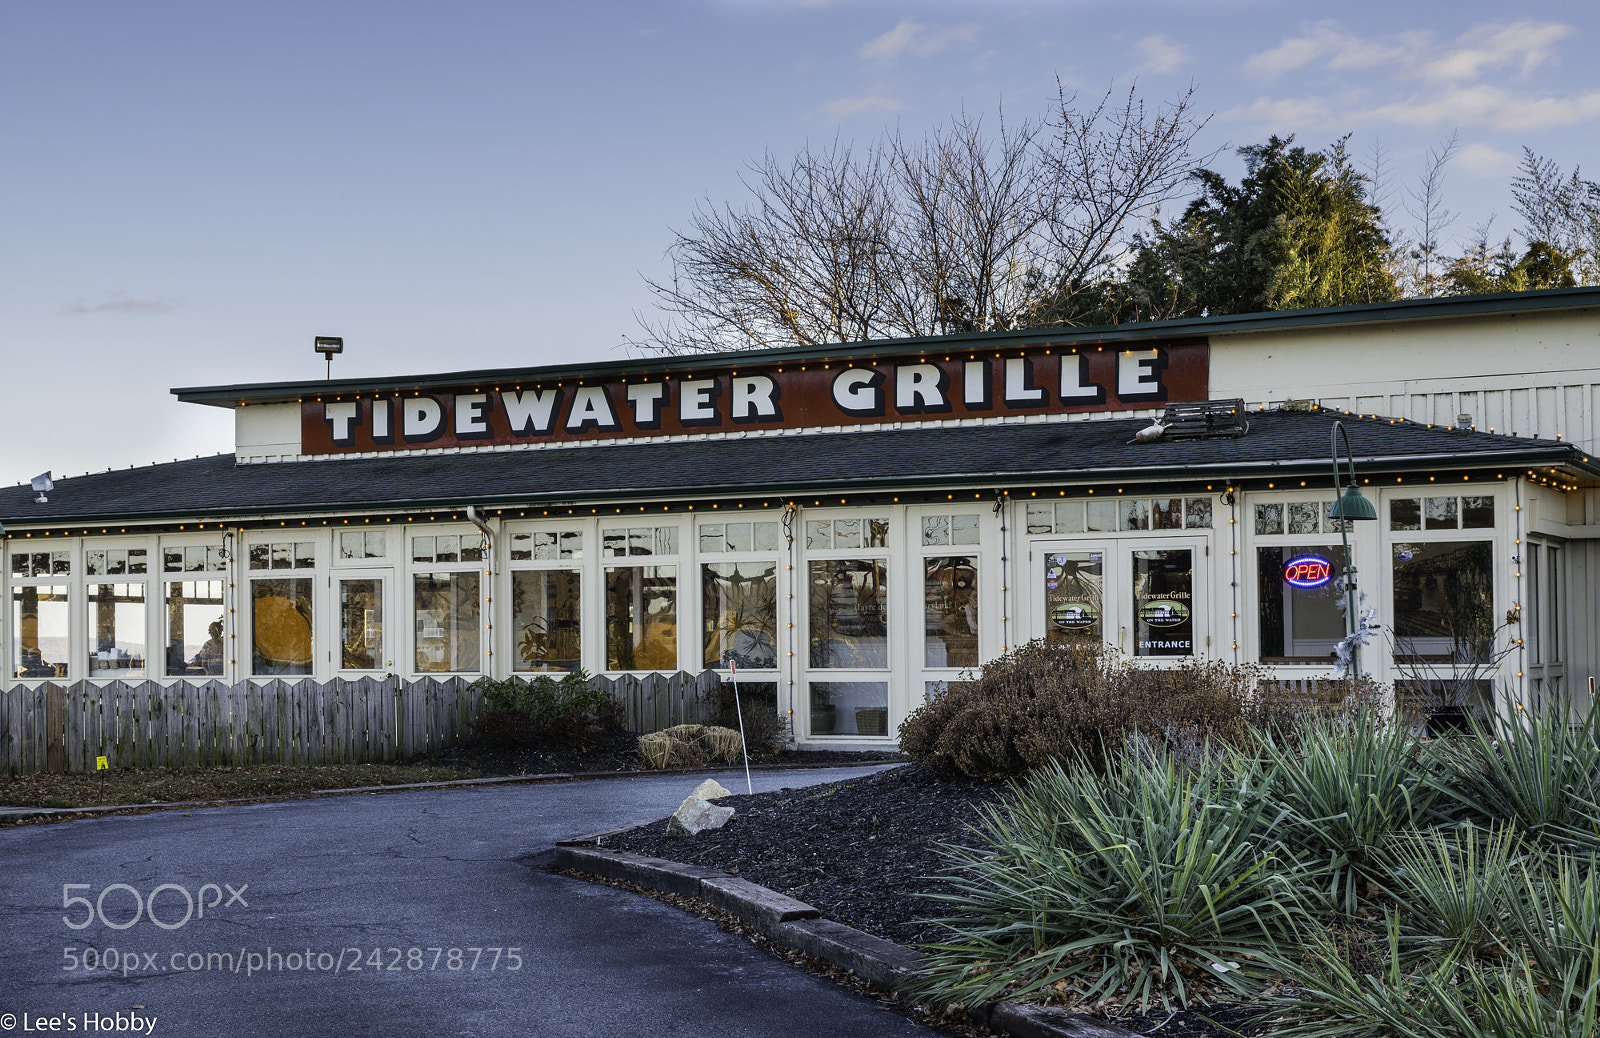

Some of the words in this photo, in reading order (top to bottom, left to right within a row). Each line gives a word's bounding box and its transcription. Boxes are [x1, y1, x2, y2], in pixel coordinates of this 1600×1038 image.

[324, 374, 778, 442] TIDEWATER
[832, 349, 1160, 411] GRILLE
[1284, 563, 1330, 581] OPEN
[1170, 590, 1191, 599] Grille
[1139, 640, 1191, 649] ENTRANCE
